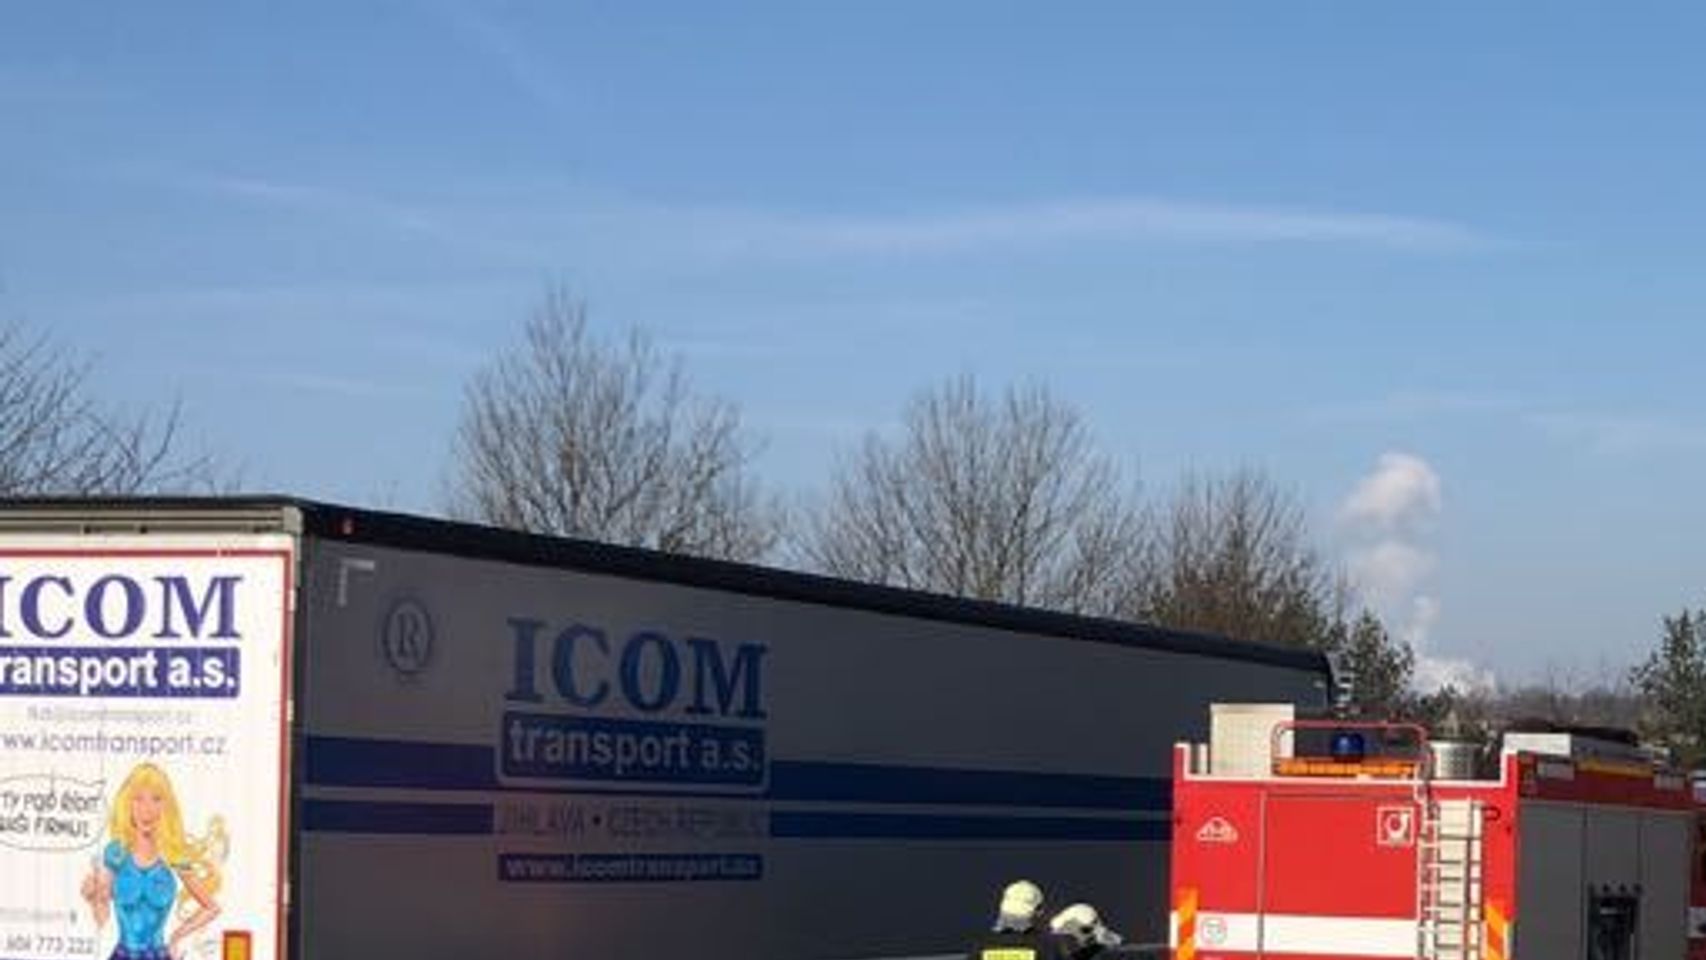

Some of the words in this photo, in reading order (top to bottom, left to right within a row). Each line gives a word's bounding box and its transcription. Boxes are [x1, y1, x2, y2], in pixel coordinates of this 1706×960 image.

[167, 658, 235, 688] a.s.
[505, 617, 769, 719] ICOM
[0, 731, 226, 757] ww.icomtransport.cz
[509, 719, 691, 776] transport
[702, 735, 762, 774] a.s.
